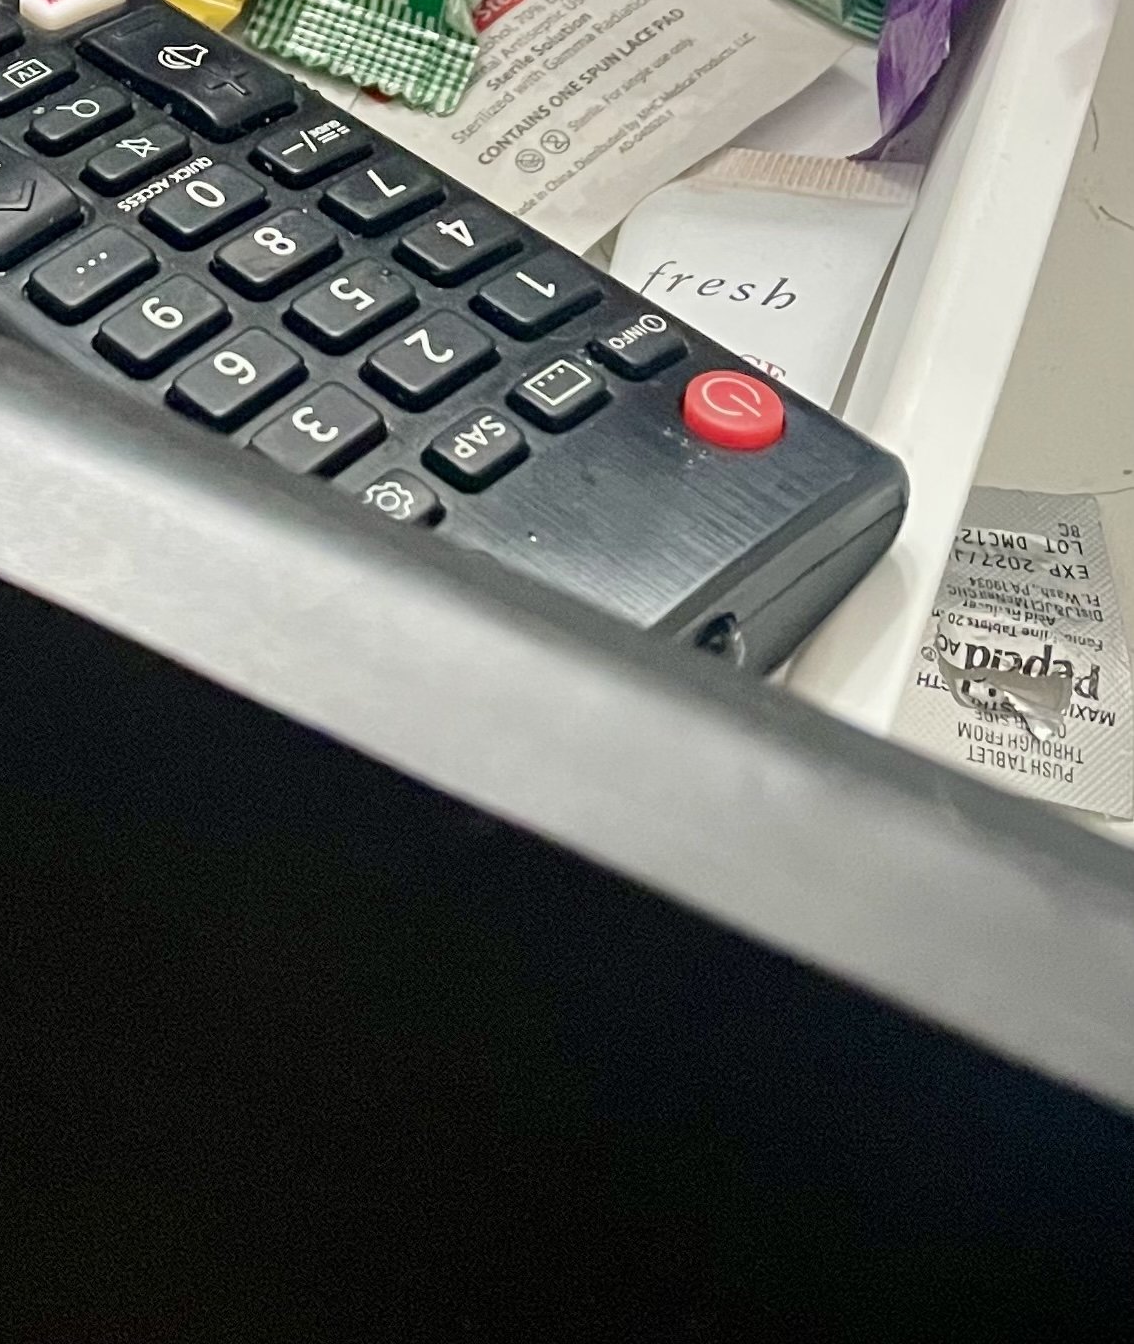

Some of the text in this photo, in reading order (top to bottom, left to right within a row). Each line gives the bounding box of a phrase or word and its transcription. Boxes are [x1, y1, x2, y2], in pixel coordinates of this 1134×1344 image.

[476, 18, 521, 56] cohol,
[514, 0, 546, 28] 70%
[500, 7, 567, 62] Antiseptic
[484, 49, 536, 93] Sterile
[530, 7, 593, 59] Solution
[15, 67, 43, 85] TV
[448, 88, 519, 147] Sterilized
[510, 65, 547, 97] with
[542, 29, 597, 74] Gamma
[473, 3, 686, 168] CONTAINS ONE SPUN LACE PAD
[601, 85, 624, 106] For
[650, 51, 672, 71] use
[116, 155, 214, 213] QUICK ACCESS
[185, 179, 226, 209] 0
[366, 169, 407, 199] 7
[252, 225, 299, 257] 8
[436, 217, 477, 248] 4
[328, 276, 376, 312] 5
[516, 269, 558, 300] 1
[639, 259, 799, 311] fresh
[140, 295, 185, 330] 9
[404, 328, 455, 364] 2
[608, 320, 647, 352] INFO
[212, 349, 258, 386] 6
[291, 405, 341, 444] 3
[452, 415, 508, 462] SAP
[952, 527, 1084, 556] LOT DMC12
[967, 576, 1007, 592] 19034
[1048, 560, 1091, 581] EXP
[1007, 582, 1030, 596] PA
[947, 611, 1018, 637] Tablets 20
[1023, 611, 1056, 626] Acid
[932, 632, 962, 657] AC
[954, 720, 1005, 746] FROM
[1004, 734, 1086, 764] THROUGH
[964, 743, 1075, 783] PUSH TABLET
